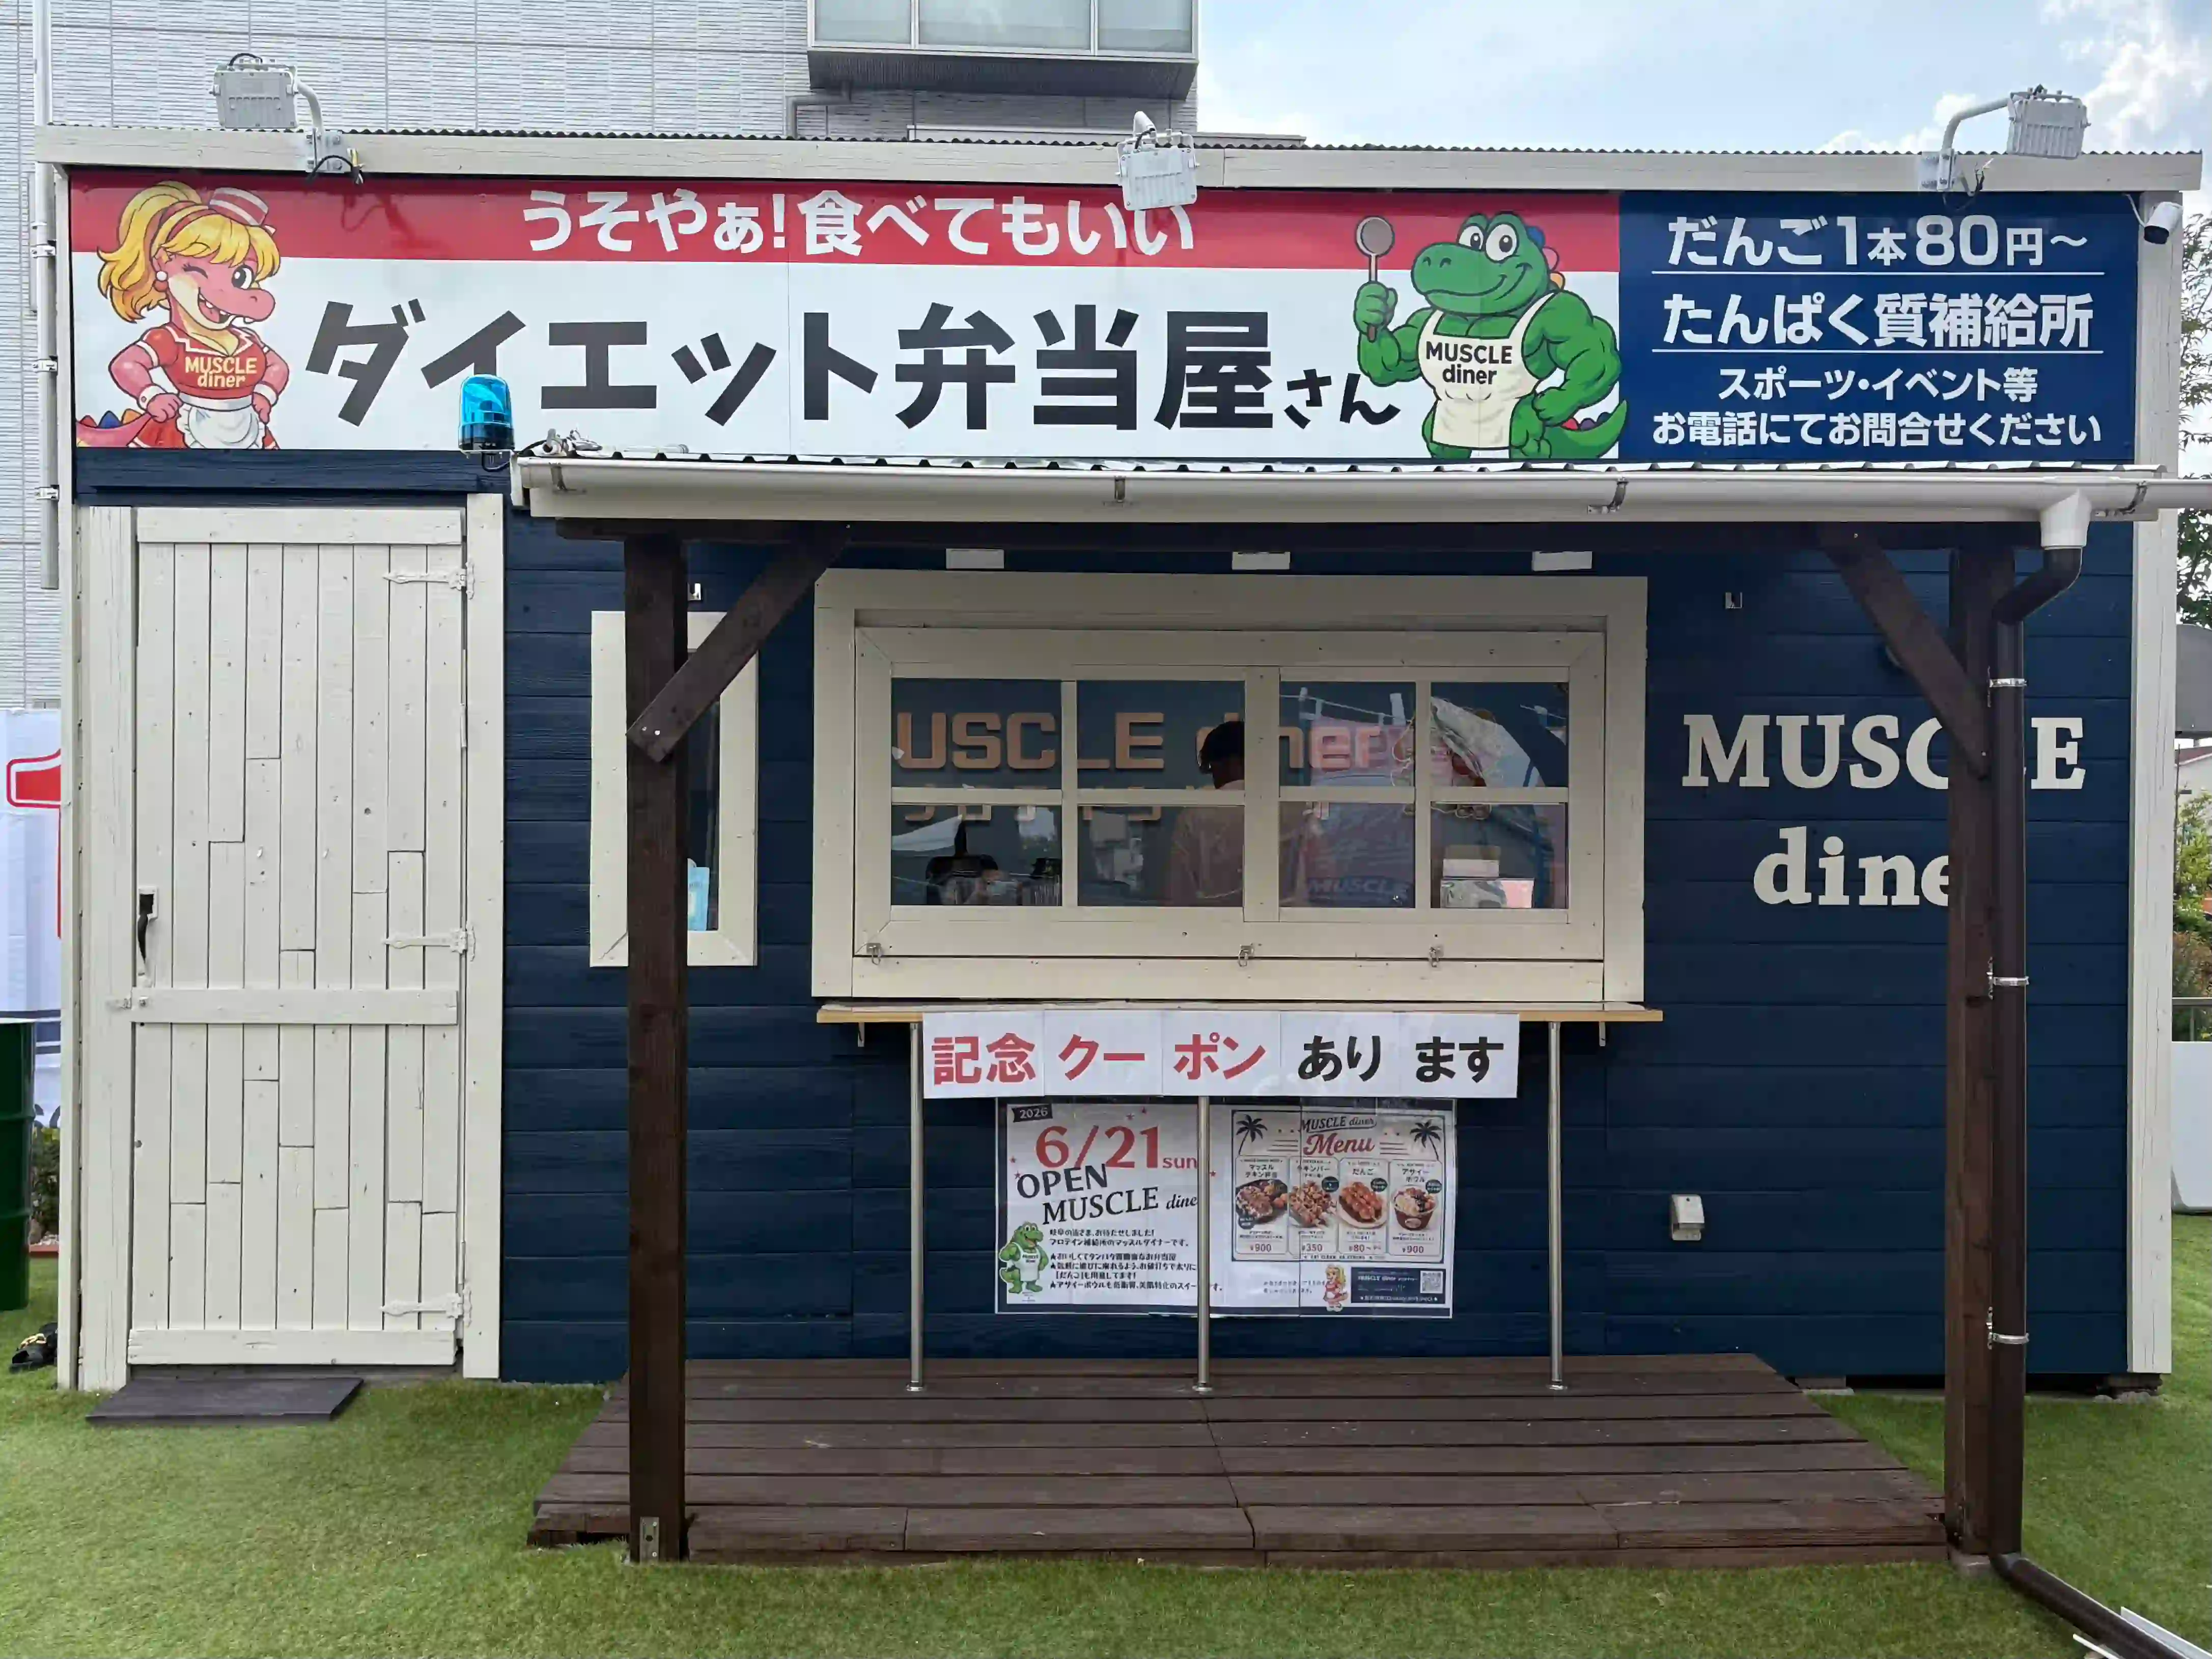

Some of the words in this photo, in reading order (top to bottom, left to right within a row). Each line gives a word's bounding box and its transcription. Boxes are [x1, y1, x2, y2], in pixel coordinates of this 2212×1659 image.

[1663, 292, 2093, 347] たんぱく質補給所
[184, 356, 257, 375] MUSCLE
[305, 298, 1401, 430] ダイエット弁当屋さん
[1425, 342, 1513, 364] MUSCLE
[197, 370, 246, 388] diner
[1442, 364, 1498, 385] diner
[1718, 366, 2038, 403] スポーツ・イベント等
[1653, 411, 2102, 447] お電話にてお問合せください
[896, 712, 1165, 770] USCE
[1682, 714, 2086, 790] MUSCE
[1753, 826, 1949, 906] dine
[1020, 1107, 1048, 1119] 2026
[1302, 1116, 1347, 1132] MUSCLE
[1035, 1124, 1160, 1169] 6/21
[1162, 1157, 1197, 1169] sun
[1303, 1133, 1375, 1156] Menu
[1017, 1163, 1108, 1199] OPEN
[1042, 1186, 1159, 1225] MUSCLE
[1165, 1193, 1198, 1211] dine
